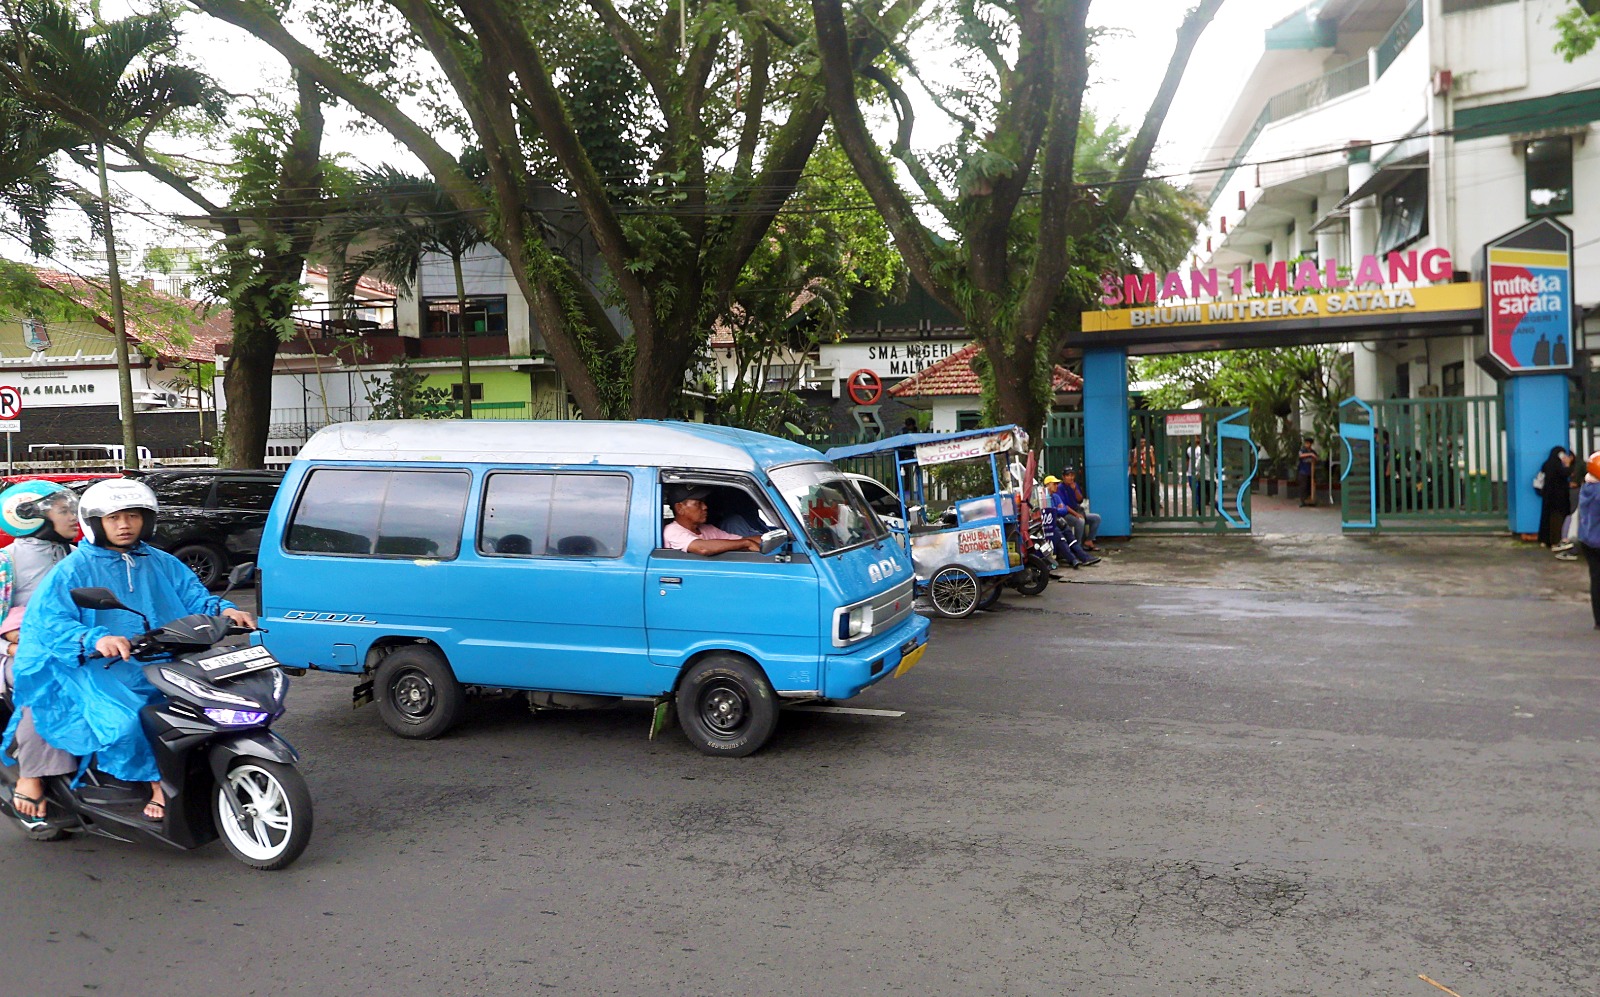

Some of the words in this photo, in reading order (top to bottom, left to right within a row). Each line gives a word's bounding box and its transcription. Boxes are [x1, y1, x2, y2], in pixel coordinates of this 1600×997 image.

[1227, 266, 1242, 295] 1
[1254, 248, 1453, 294] MALANG
[1131, 305, 1202, 327] BHUMI
[1209, 297, 1318, 321] MITREKA
[1327, 290, 1415, 313] SATATA
[1498, 293, 1562, 315] satata
[868, 345, 898, 360] SMA
[33, 386, 41, 395] 4
[44, 384, 95, 395] MALANG
[921, 447, 980, 462] SOTONG
[938, 444, 960, 453] DAN
[959, 541, 989, 554] SOTONG
[868, 556, 902, 584] ADL
